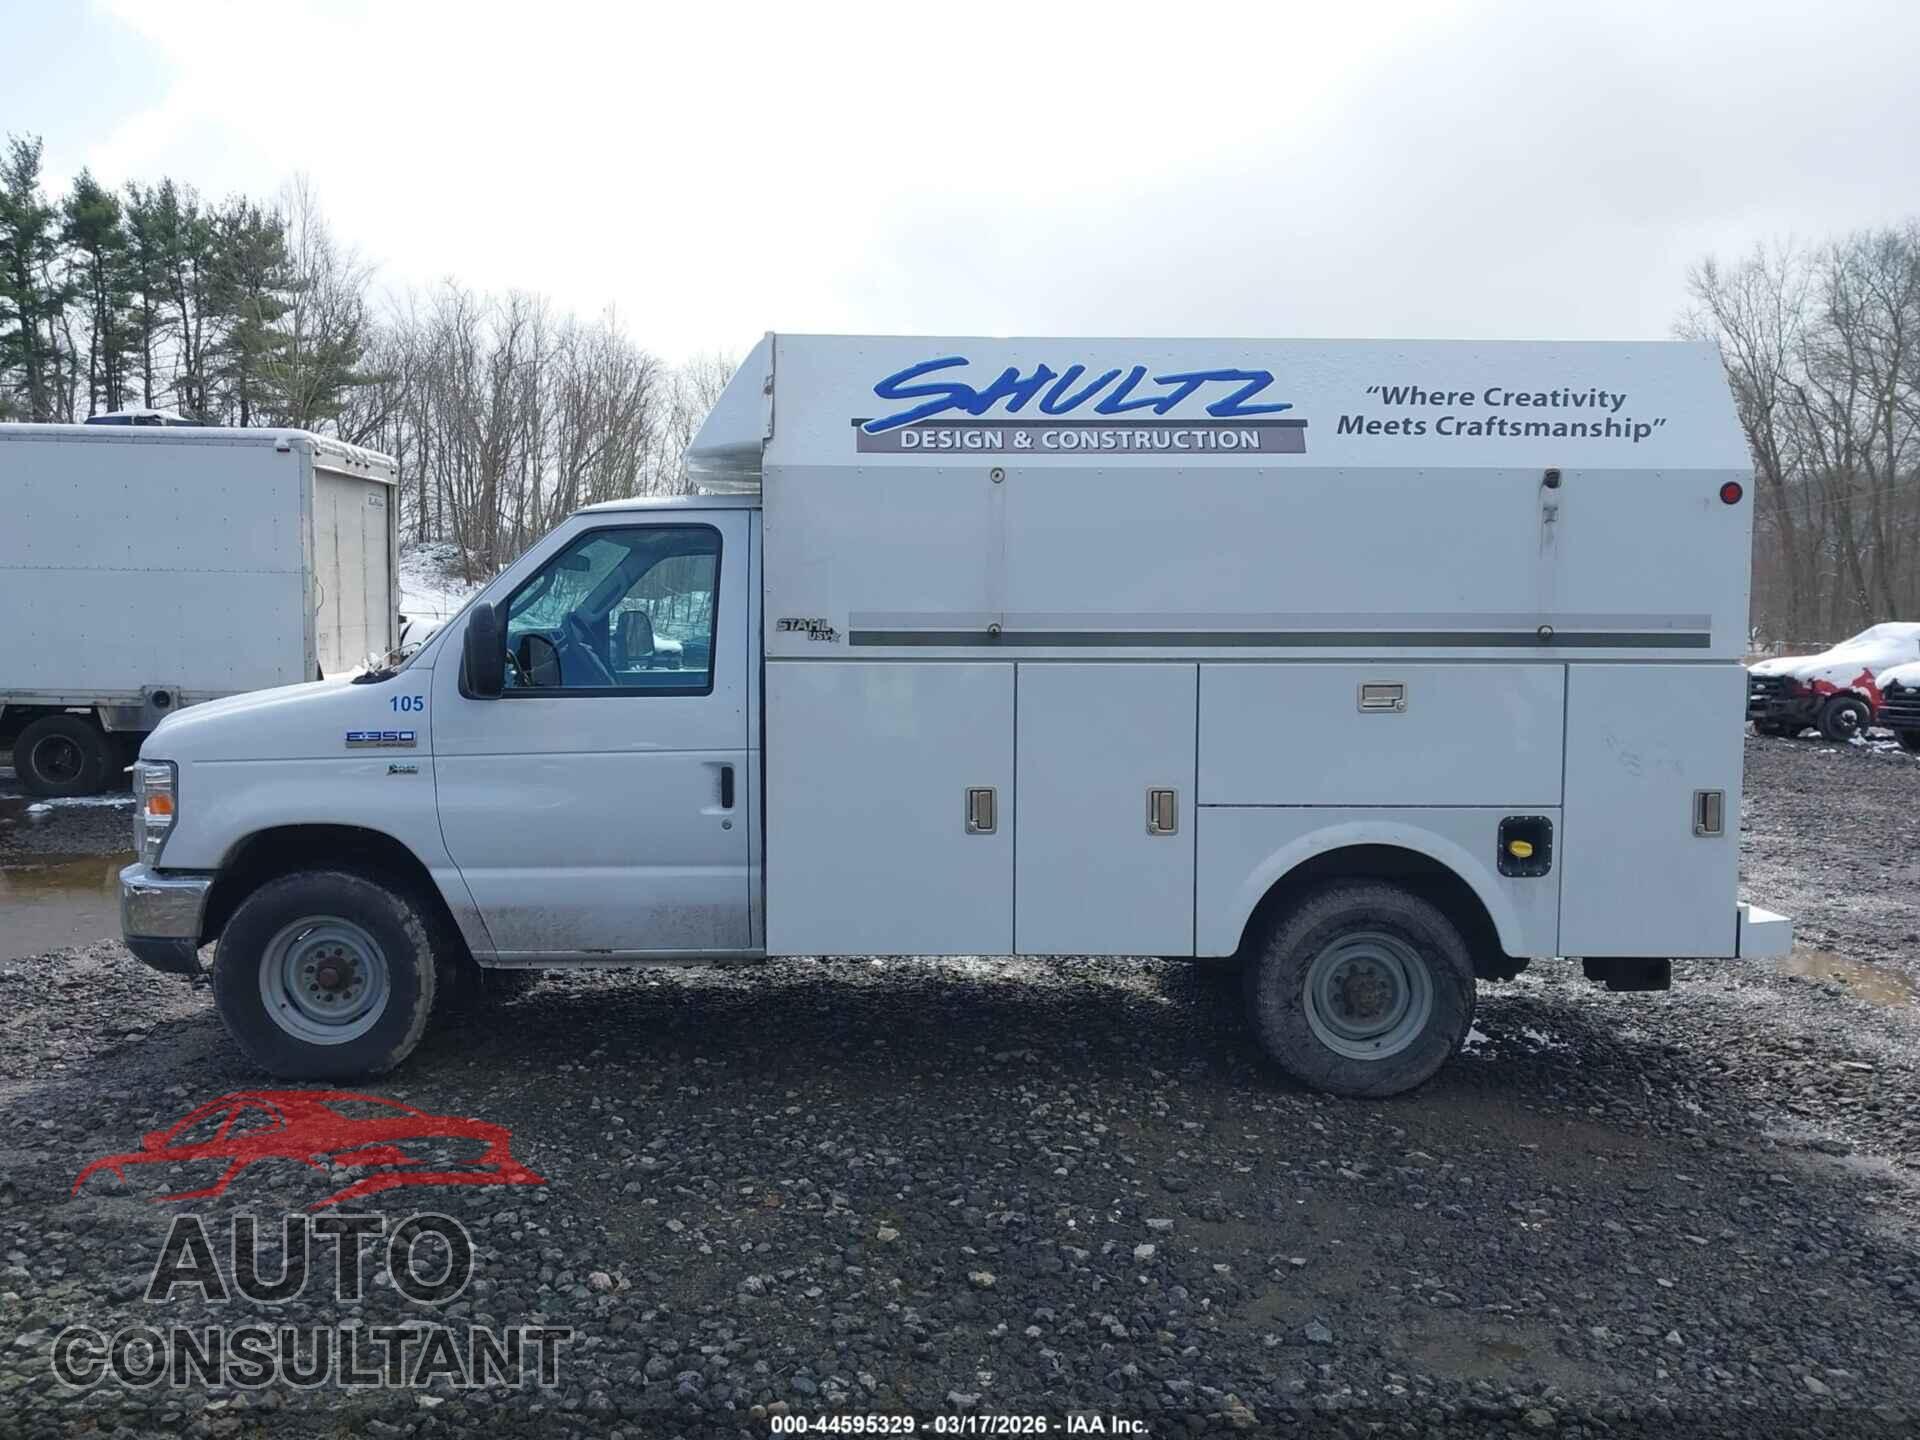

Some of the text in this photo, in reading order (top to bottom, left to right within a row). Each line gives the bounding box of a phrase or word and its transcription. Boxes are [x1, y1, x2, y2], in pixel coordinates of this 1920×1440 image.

[863, 356, 1293, 433] SHULTZ
[1366, 386, 1627, 413] “Where Creativity
[900, 431, 1261, 450] DESIGN & CONSTRUCTION
[1337, 415, 1667, 443] Meets Craftsmanship”
[776, 618, 832, 632] STAHL
[390, 696, 424, 712] 105
